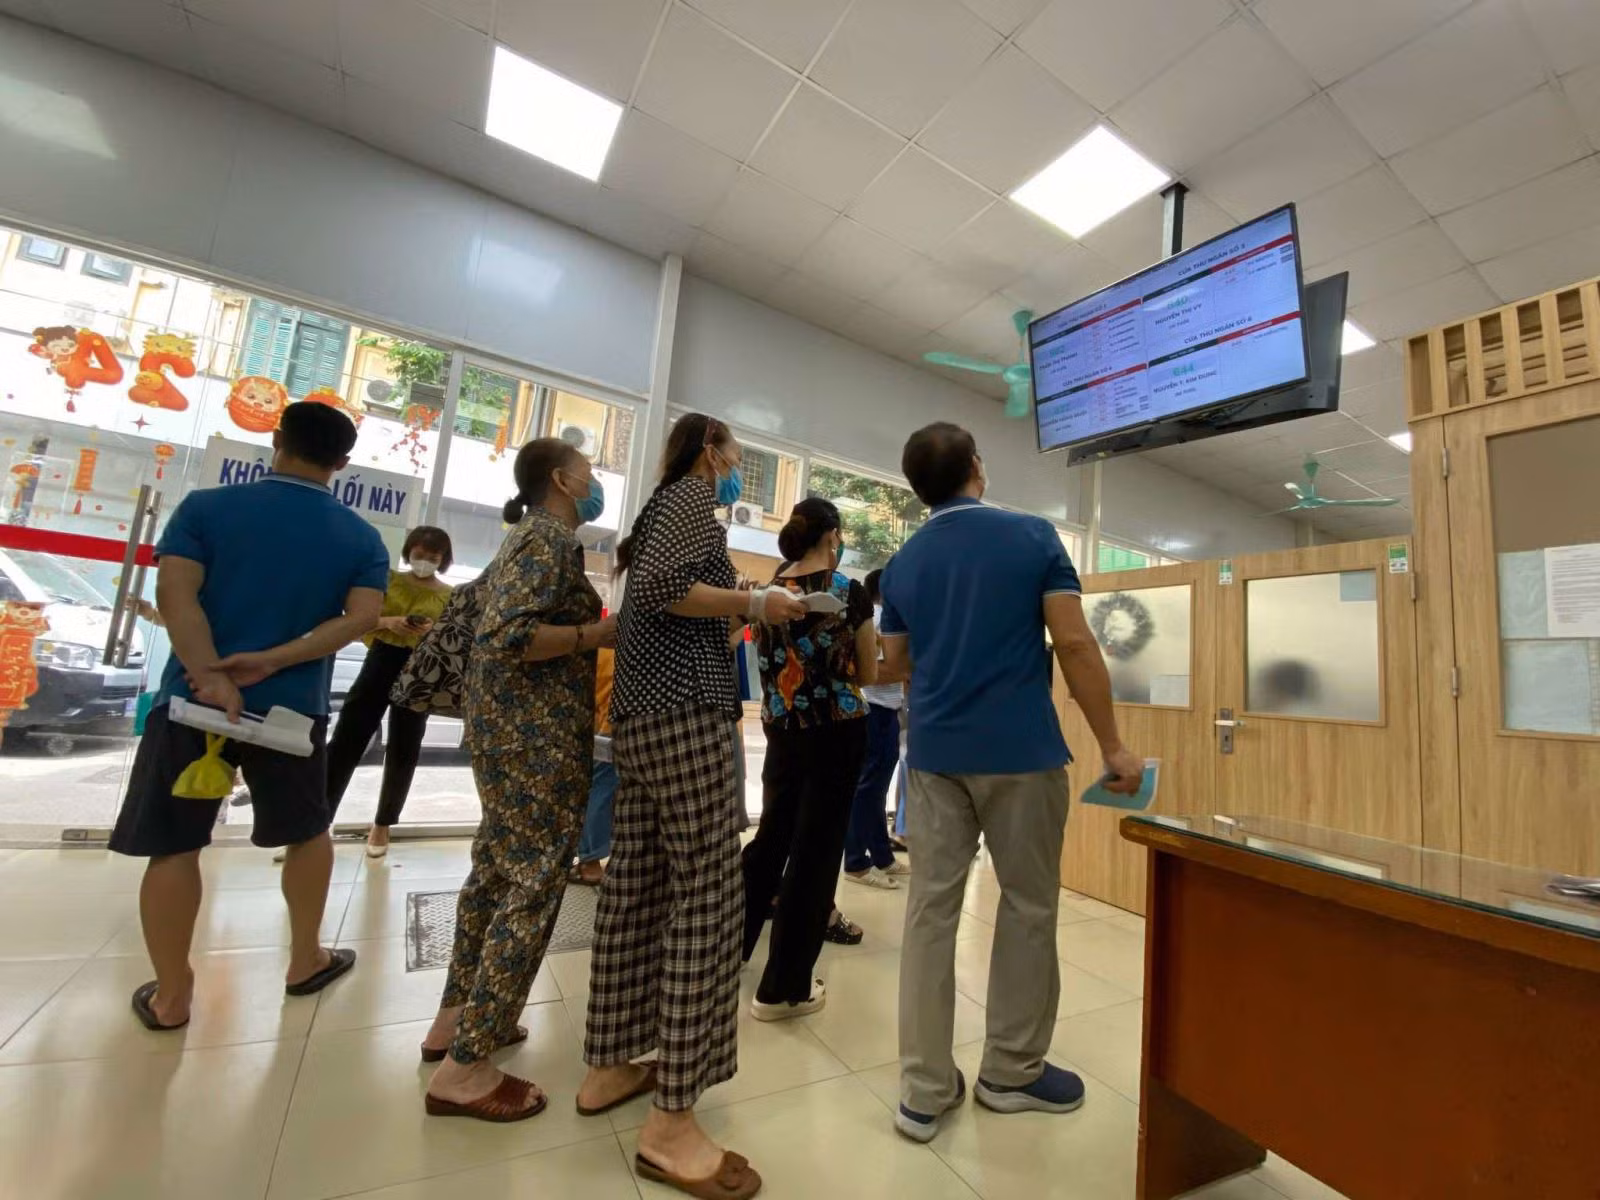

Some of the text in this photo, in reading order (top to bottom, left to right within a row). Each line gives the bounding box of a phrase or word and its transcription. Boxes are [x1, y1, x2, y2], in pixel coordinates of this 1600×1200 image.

[219, 457, 407, 515] KHÔ LỐI NÀY
